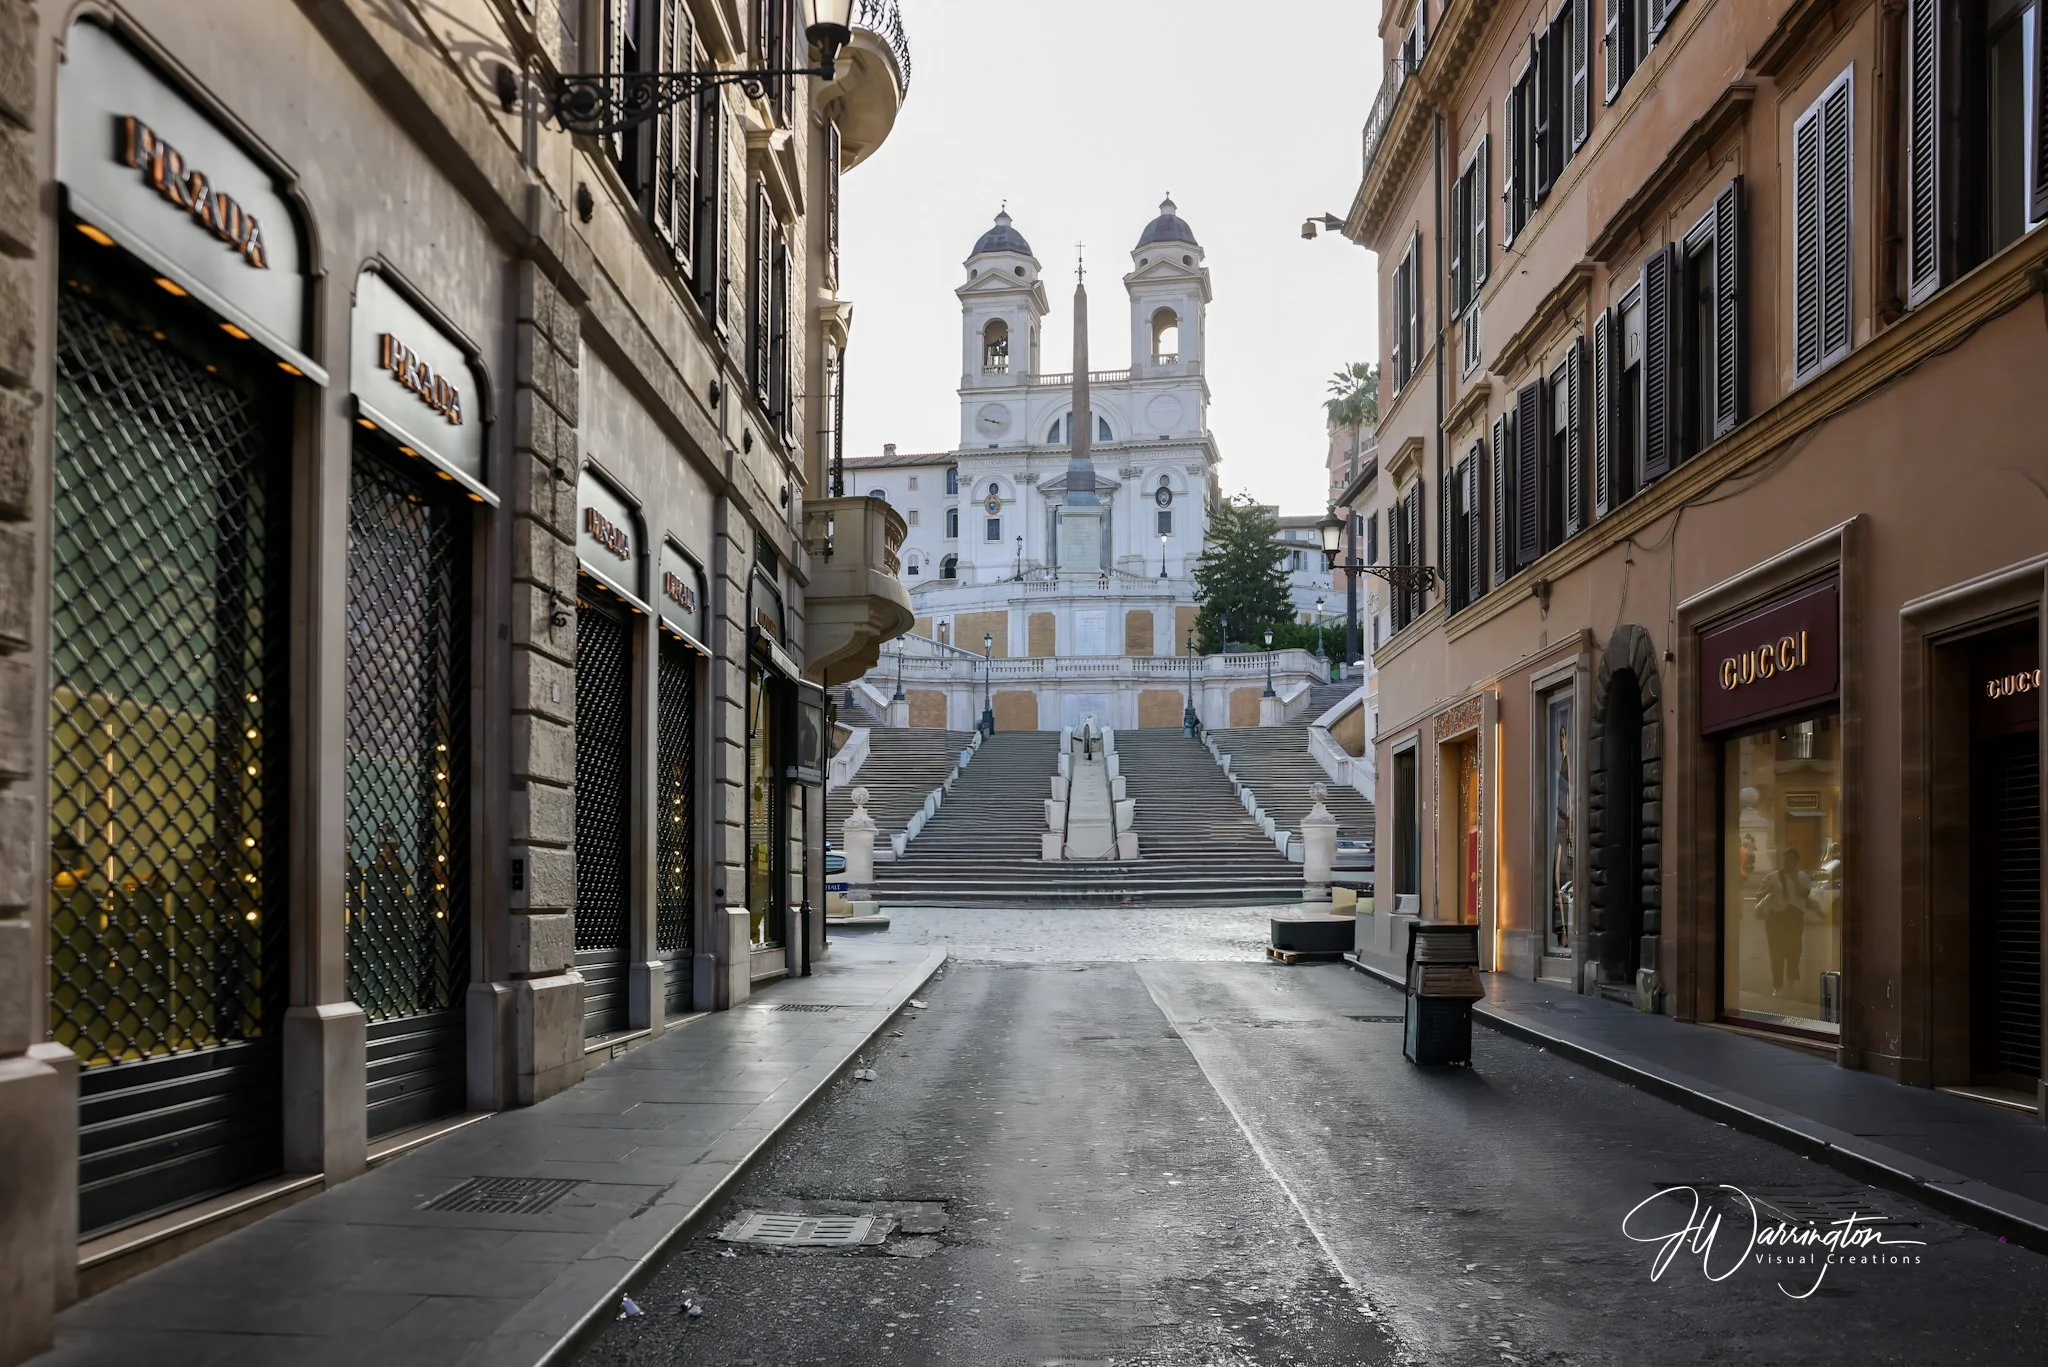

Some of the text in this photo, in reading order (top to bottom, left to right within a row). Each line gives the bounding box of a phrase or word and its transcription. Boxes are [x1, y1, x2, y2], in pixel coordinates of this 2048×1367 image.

[125, 116, 267, 268] PRADA
[382, 332, 463, 424] PRADA
[587, 508, 630, 560] PRADA
[1719, 631, 1807, 690] GUCCI
